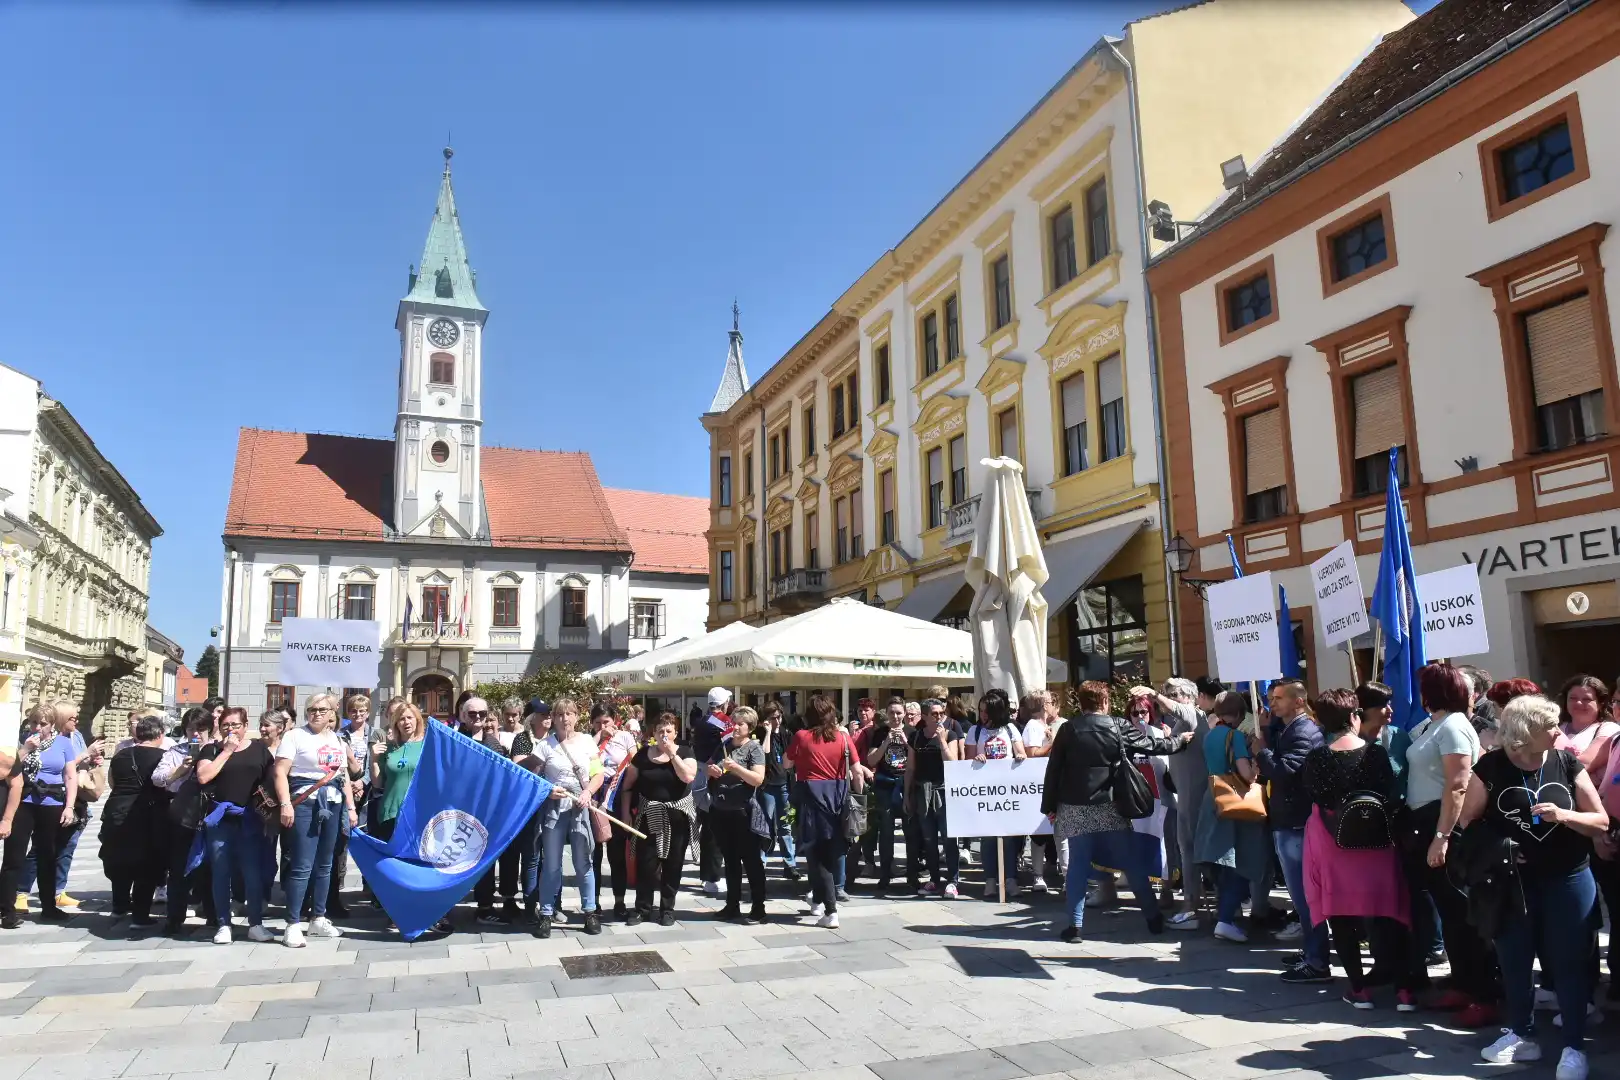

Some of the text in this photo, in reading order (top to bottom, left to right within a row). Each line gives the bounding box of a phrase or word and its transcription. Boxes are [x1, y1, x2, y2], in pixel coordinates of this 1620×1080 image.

[1331, 583, 1338, 595] ZA
[1431, 593, 1475, 613] USKOK
[1223, 618, 1245, 629] GODINA
[1246, 611, 1273, 626] PONOSA
[1352, 611, 1360, 626] TO
[1448, 613, 1474, 628] VAS
[287, 642, 372, 653] HRVATSKA TREBA
[307, 654, 351, 663] VARTEKS
[774, 654, 812, 668] PAN
[853, 658, 890, 671] PAN
[936, 661, 971, 675] PAN
[950, 782, 1044, 797] HOĆEMO NAŠE
[977, 798, 1020, 812] PLAĆE
